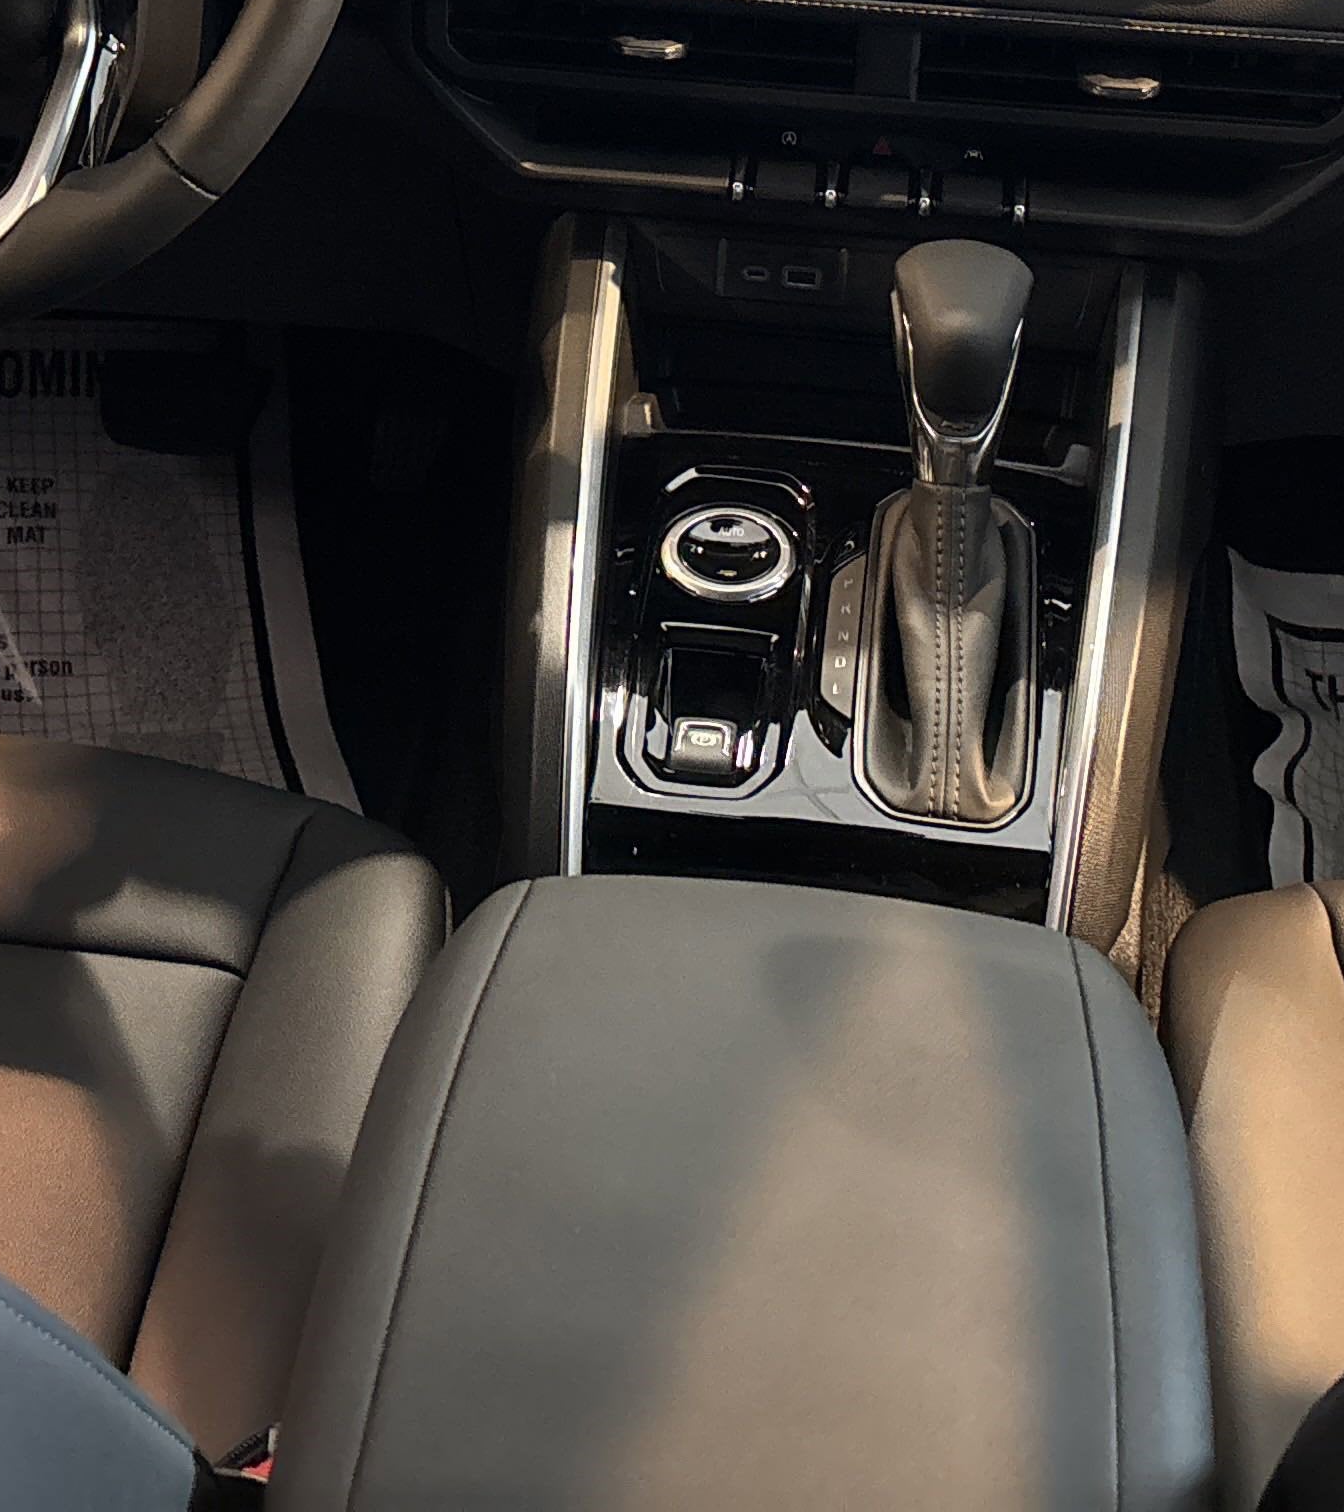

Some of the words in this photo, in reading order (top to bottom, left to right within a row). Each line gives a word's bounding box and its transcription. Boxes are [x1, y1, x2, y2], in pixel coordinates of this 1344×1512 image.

[7, 475, 55, 495] KEEP
[6, 525, 48, 545] MAT
[719, 527, 744, 537] AUTO
[837, 631, 849, 642] N
[834, 656, 847, 668] D
[5, 659, 74, 681] prson
[831, 682, 840, 695] L
